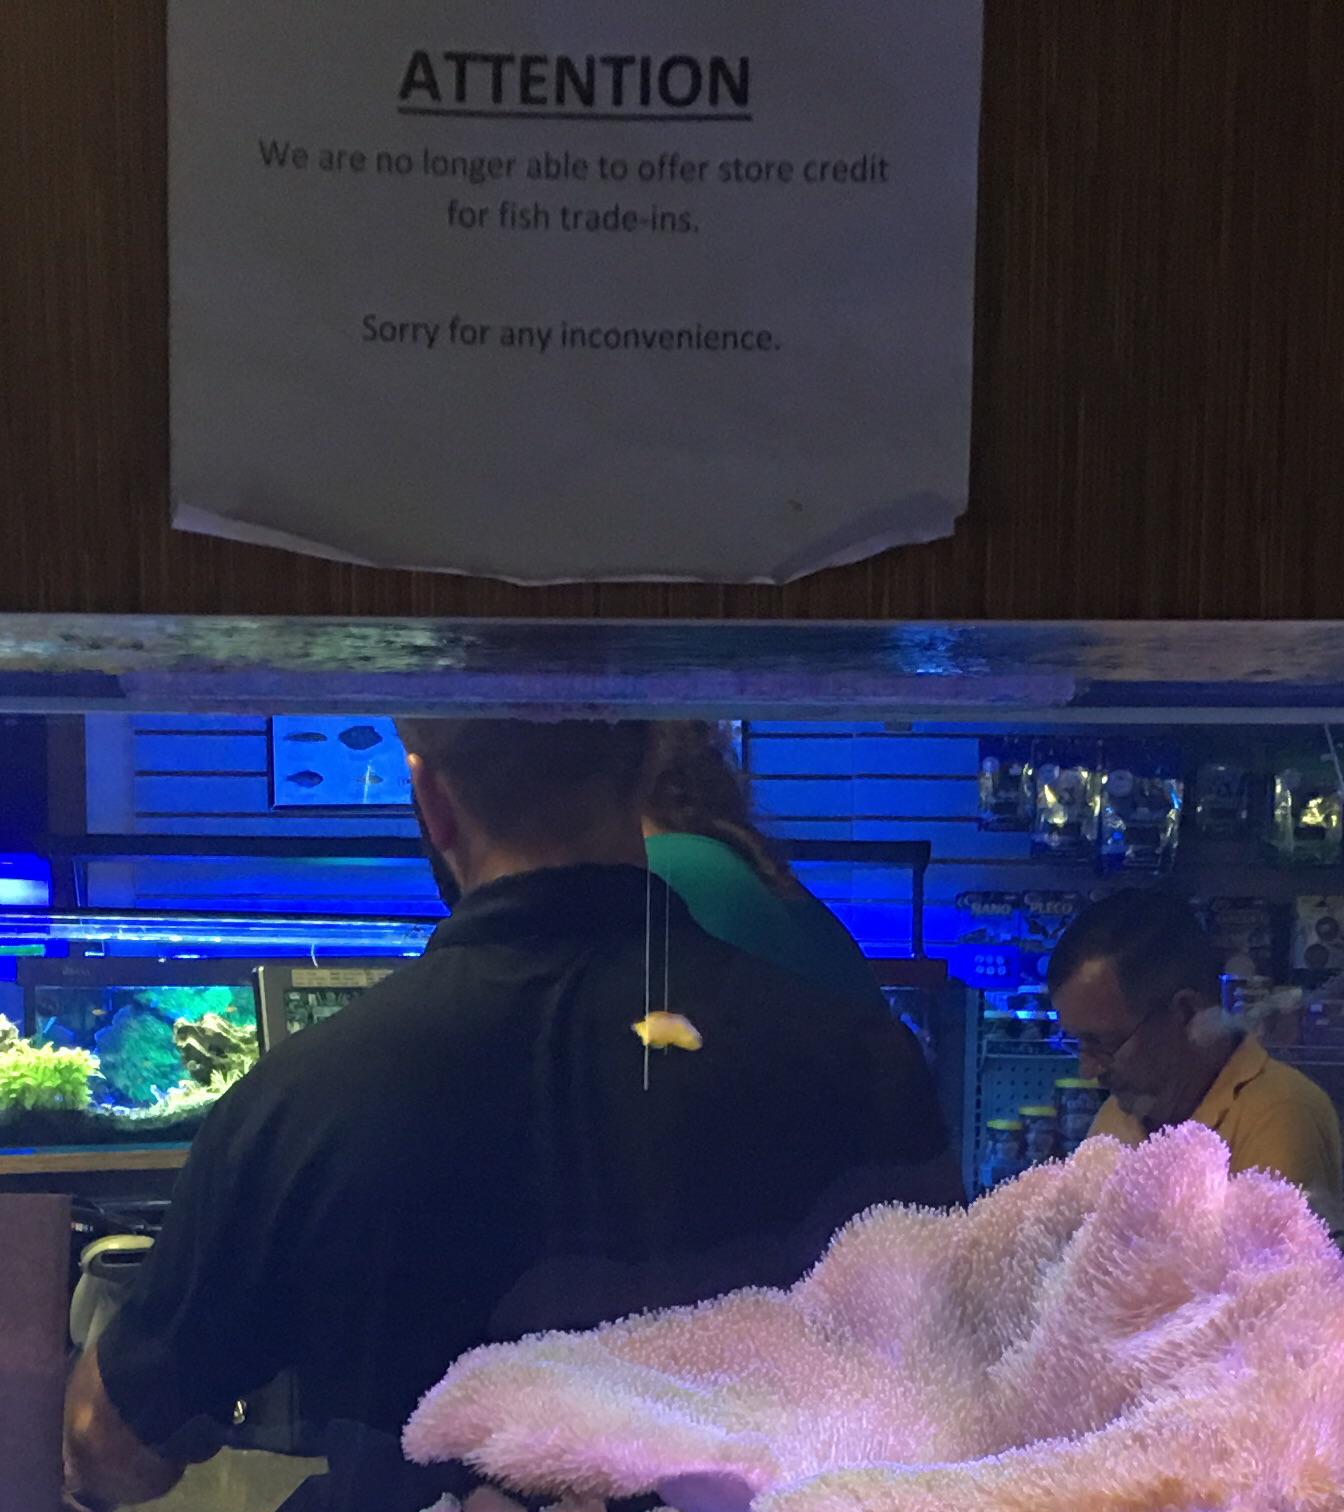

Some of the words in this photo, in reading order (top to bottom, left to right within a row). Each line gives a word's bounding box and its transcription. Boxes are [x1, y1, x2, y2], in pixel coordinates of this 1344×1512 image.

[398, 50, 753, 121] ATTENTION
[259, 138, 309, 169] We
[319, 150, 367, 172] are
[377, 152, 413, 175] no
[424, 149, 516, 184] longer
[526, 151, 588, 180] able
[599, 156, 628, 181] to
[638, 152, 710, 182] offer
[718, 157, 794, 183] store
[803, 153, 890, 183] credit
[448, 199, 489, 229] for
[499, 200, 550, 231] fish
[560, 202, 699, 234] trade-ins.
[362, 313, 440, 349] Sorry
[449, 315, 491, 346] for
[499, 322, 554, 354] any
[560, 320, 783, 352] inconvenience.
[1030, 902, 1074, 914] PLECO
